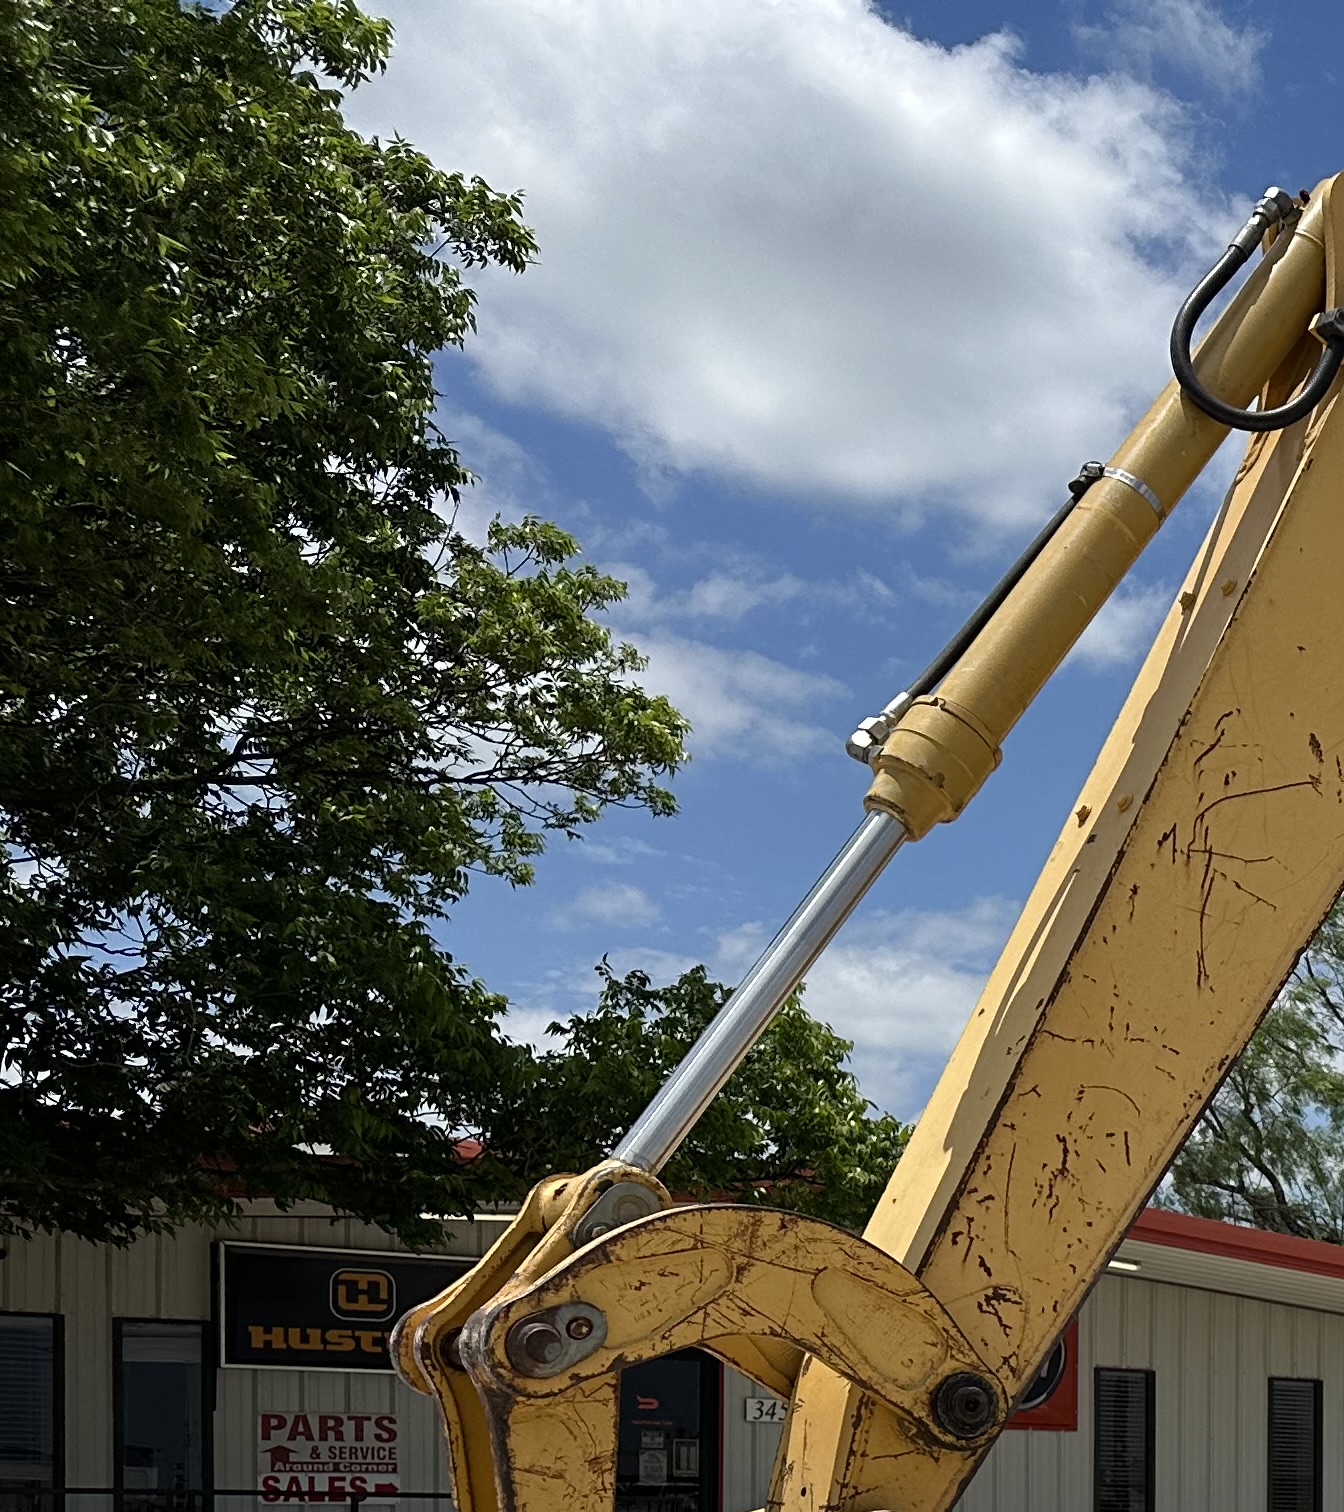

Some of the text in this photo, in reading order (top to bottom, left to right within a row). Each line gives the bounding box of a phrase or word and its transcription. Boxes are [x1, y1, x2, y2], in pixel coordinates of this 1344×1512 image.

[249, 1326, 390, 1353] HUST
[261, 1413, 398, 1443] PARTS
[309, 1446, 397, 1460] & SERVICE
[273, 1461, 395, 1473] Around Corner
[261, 1475, 368, 1503] SALES
